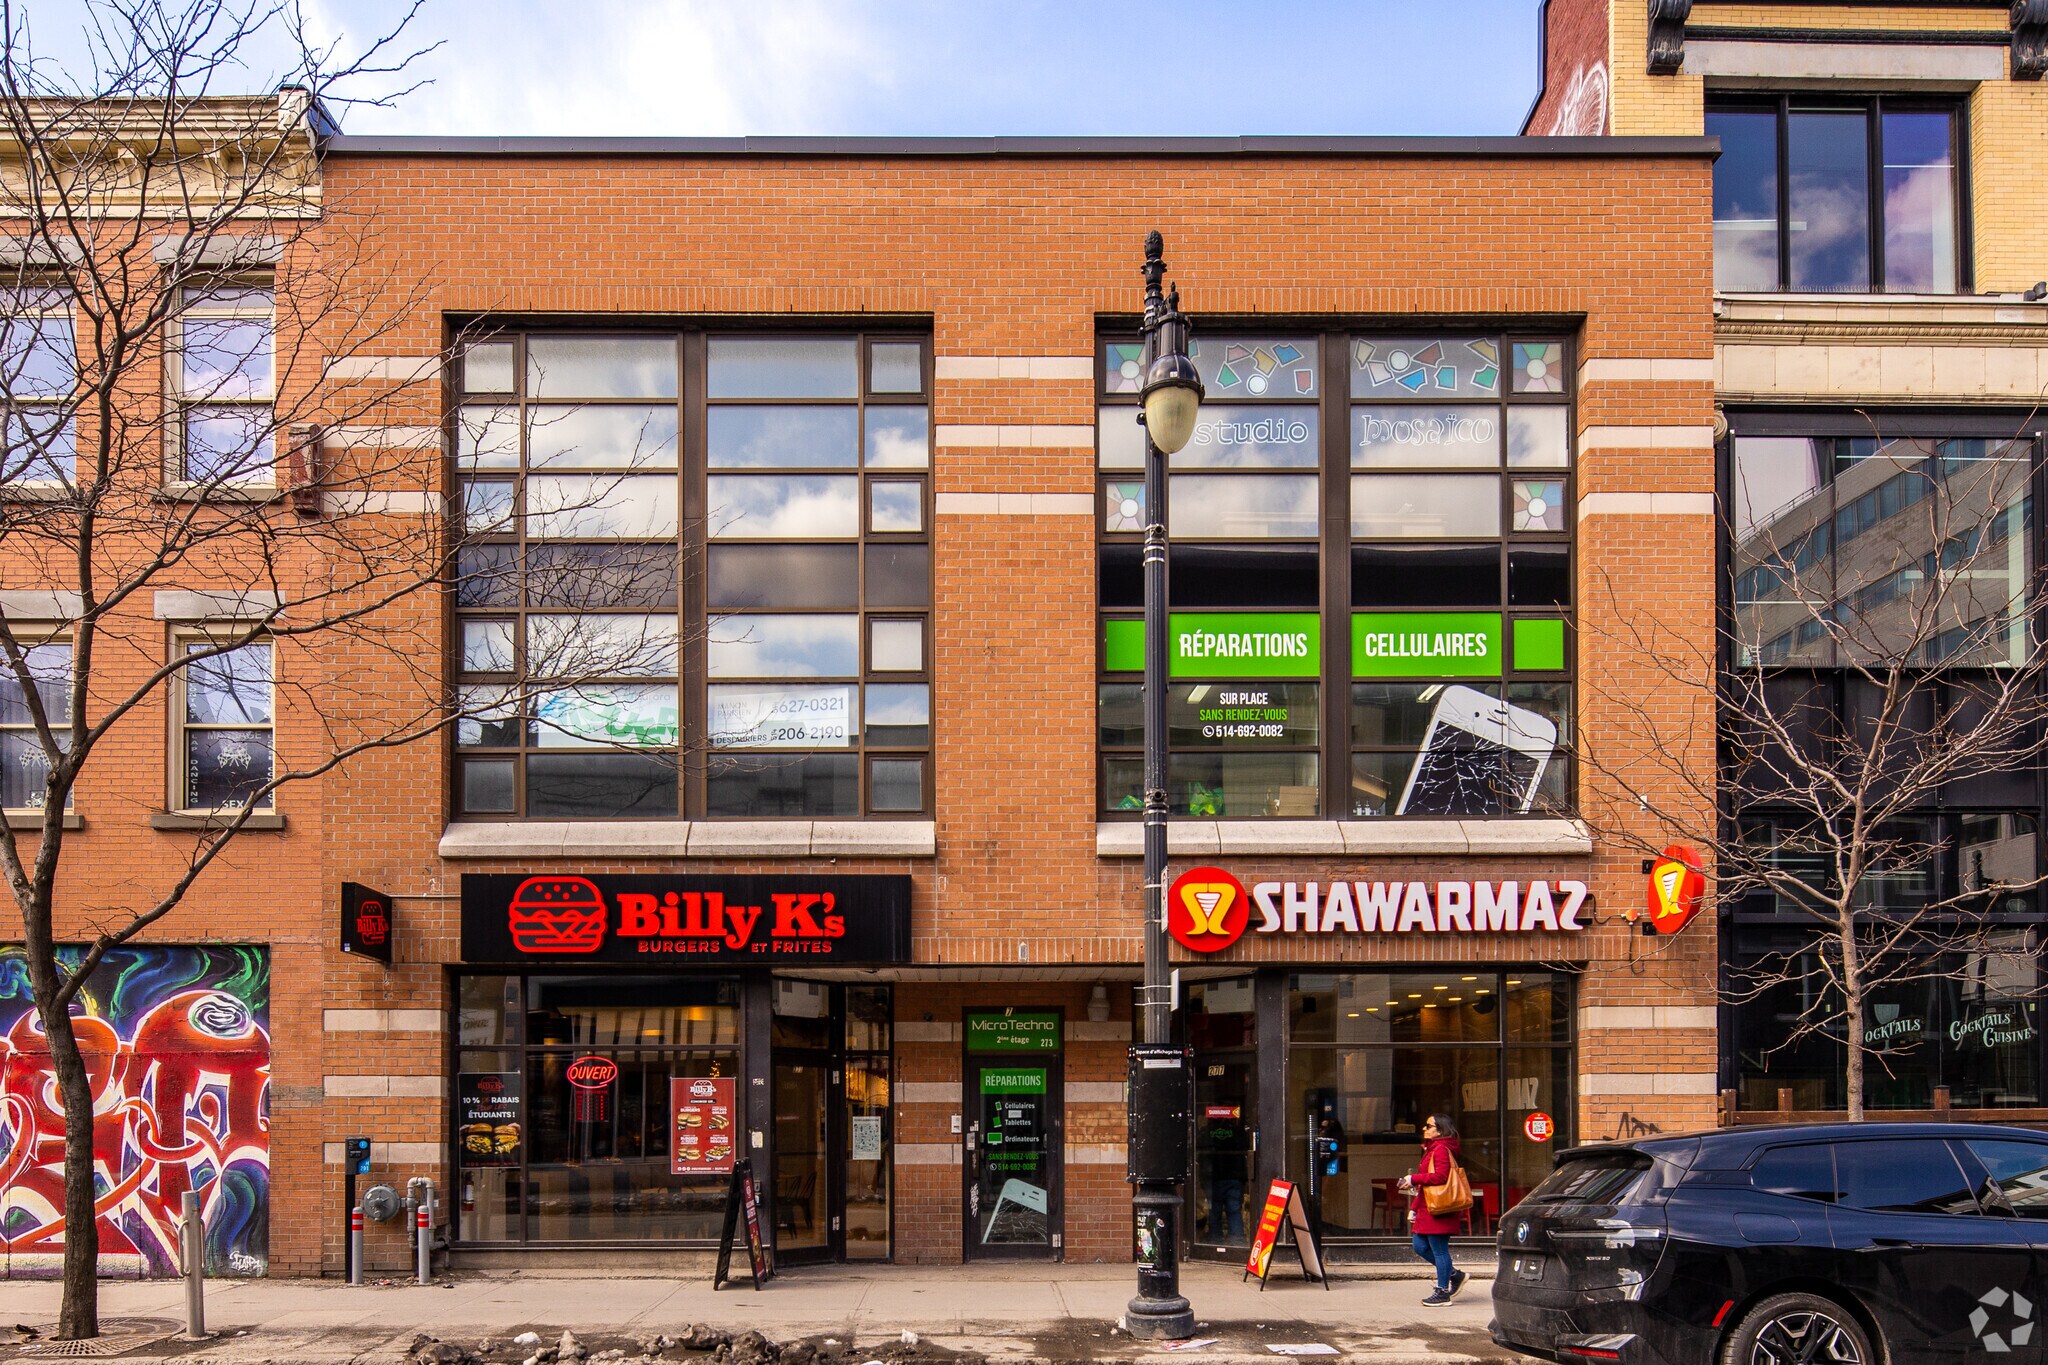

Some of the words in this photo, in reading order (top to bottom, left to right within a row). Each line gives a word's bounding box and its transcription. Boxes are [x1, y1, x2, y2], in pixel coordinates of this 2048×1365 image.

[1193, 418, 1309, 446] studio
[1358, 412, 1495, 446] mosaïco
[1179, 628, 1308, 658] RÉPARATIONS
[1365, 632, 1487, 658] CELLULAIRES
[779, 696, 844, 713] 627-0321
[1220, 692, 1238, 706] SUR
[1239, 692, 1269, 706] PLACE
[1199, 707, 1224, 721] SANS
[1225, 707, 1288, 721] RENDEZ-VOUS
[778, 725, 844, 741] 206-2190
[1215, 724, 1284, 738] 514-692-0082
[190, 759, 199, 803] DANCING
[222, 800, 245, 809] SEX
[1252, 879, 1588, 933] SHAWARMAZ
[357, 918, 378, 934] Billy
[617, 892, 762, 949] Billy
[771, 892, 846, 937] K's
[637, 940, 720, 953] BURGERS
[751, 943, 767, 953] ET
[772, 940, 833, 953] FRITES
[971, 1019, 1054, 1031] MicroTechno
[1010, 1035, 1030, 1045] étage
[1040, 1038, 1053, 1048] 273
[569, 1066, 614, 1080] OUVERT
[985, 1073, 1042, 1087] RÉPARATIONS
[491, 1096, 519, 1104] RABAIS
[1004, 1102, 1035, 1110] Cellulaires
[1004, 1135, 1040, 1143] Ordinateurs
[988, 1152, 1003, 1160] SANS
[1003, 1152, 1039, 1160] RENDEZ-VOUS
[997, 1162, 1037, 1171] 514-692-0082
